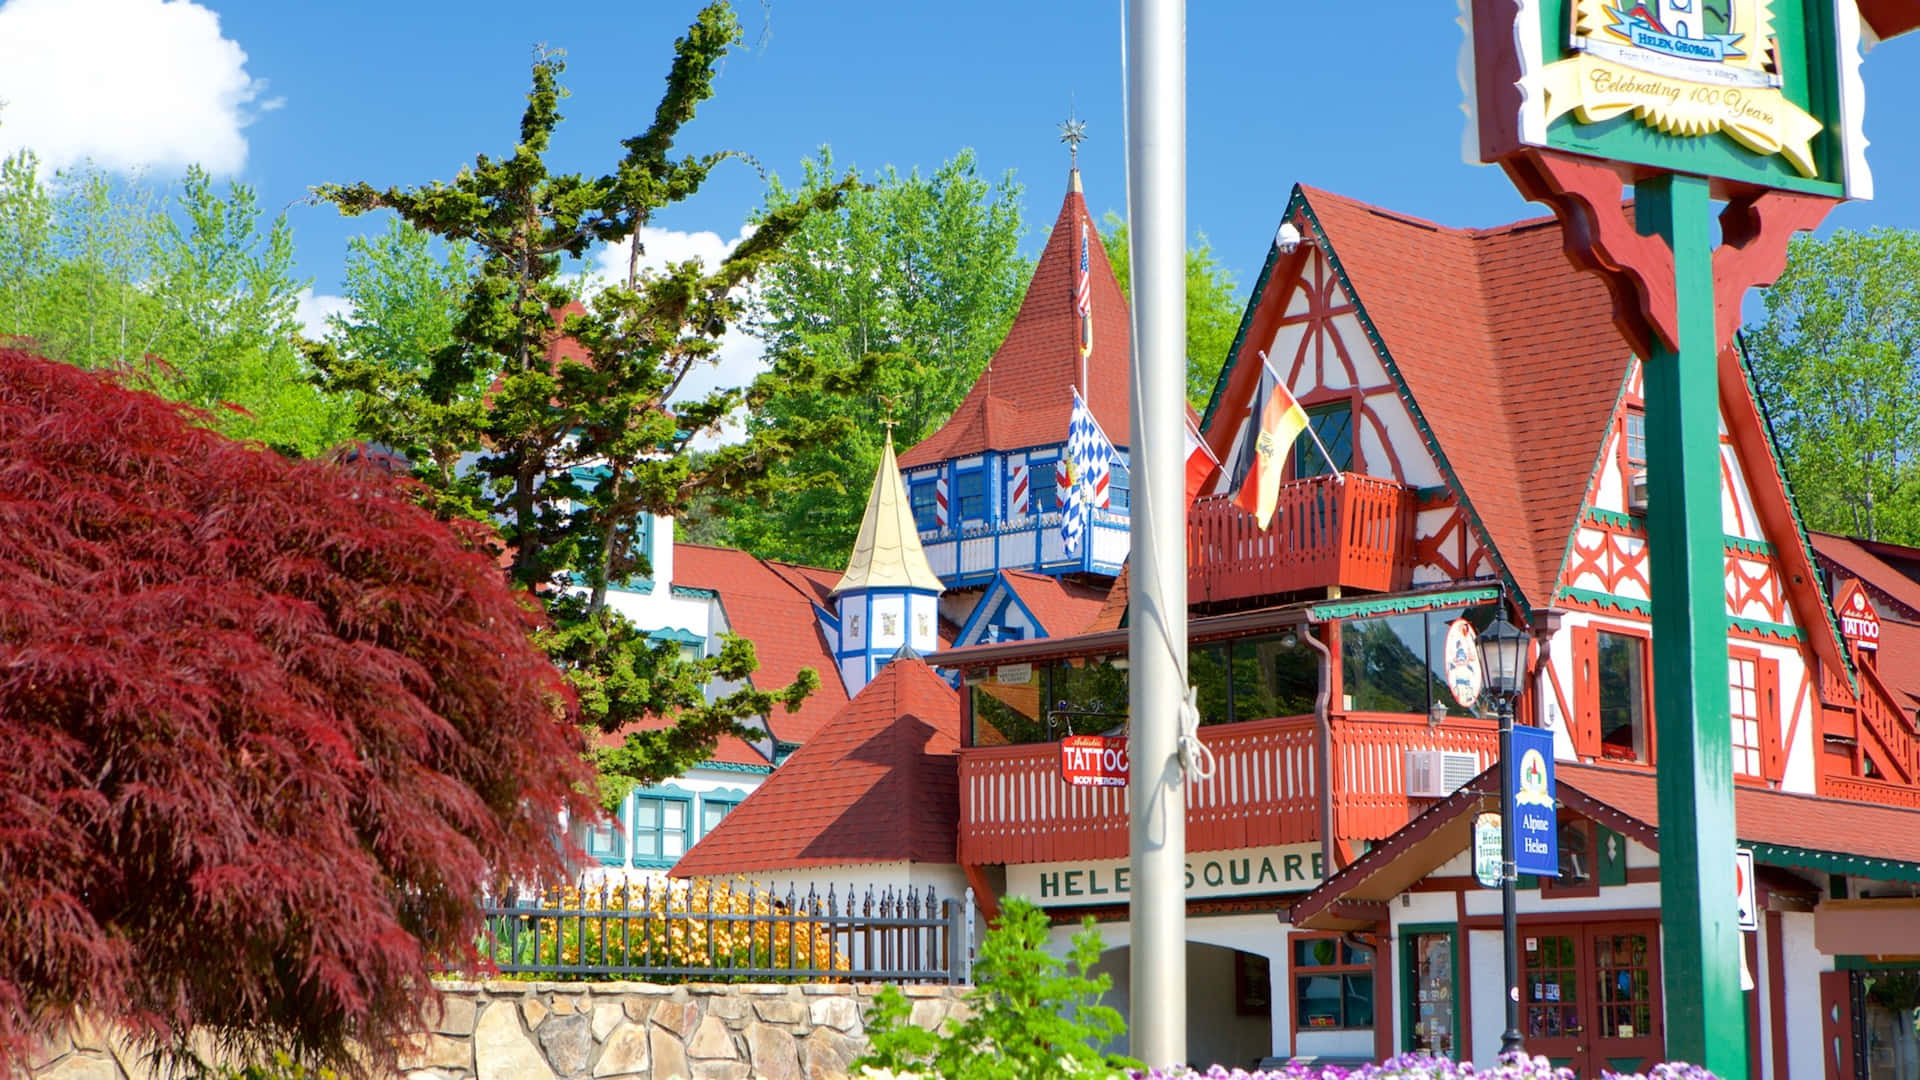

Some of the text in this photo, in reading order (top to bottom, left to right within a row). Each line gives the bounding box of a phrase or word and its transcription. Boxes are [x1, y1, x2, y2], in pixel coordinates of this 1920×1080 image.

[1675, 40, 1716, 58] GEORGIA
[1590, 68, 1775, 125] Celebrating 100 Years
[1842, 616, 1879, 638] TATTOO
[1073, 776, 1126, 786] BODY PIERCING
[1522, 814, 1549, 834] Alpine
[1524, 837, 1549, 855] Helen
[1040, 867, 1130, 898] HELE
